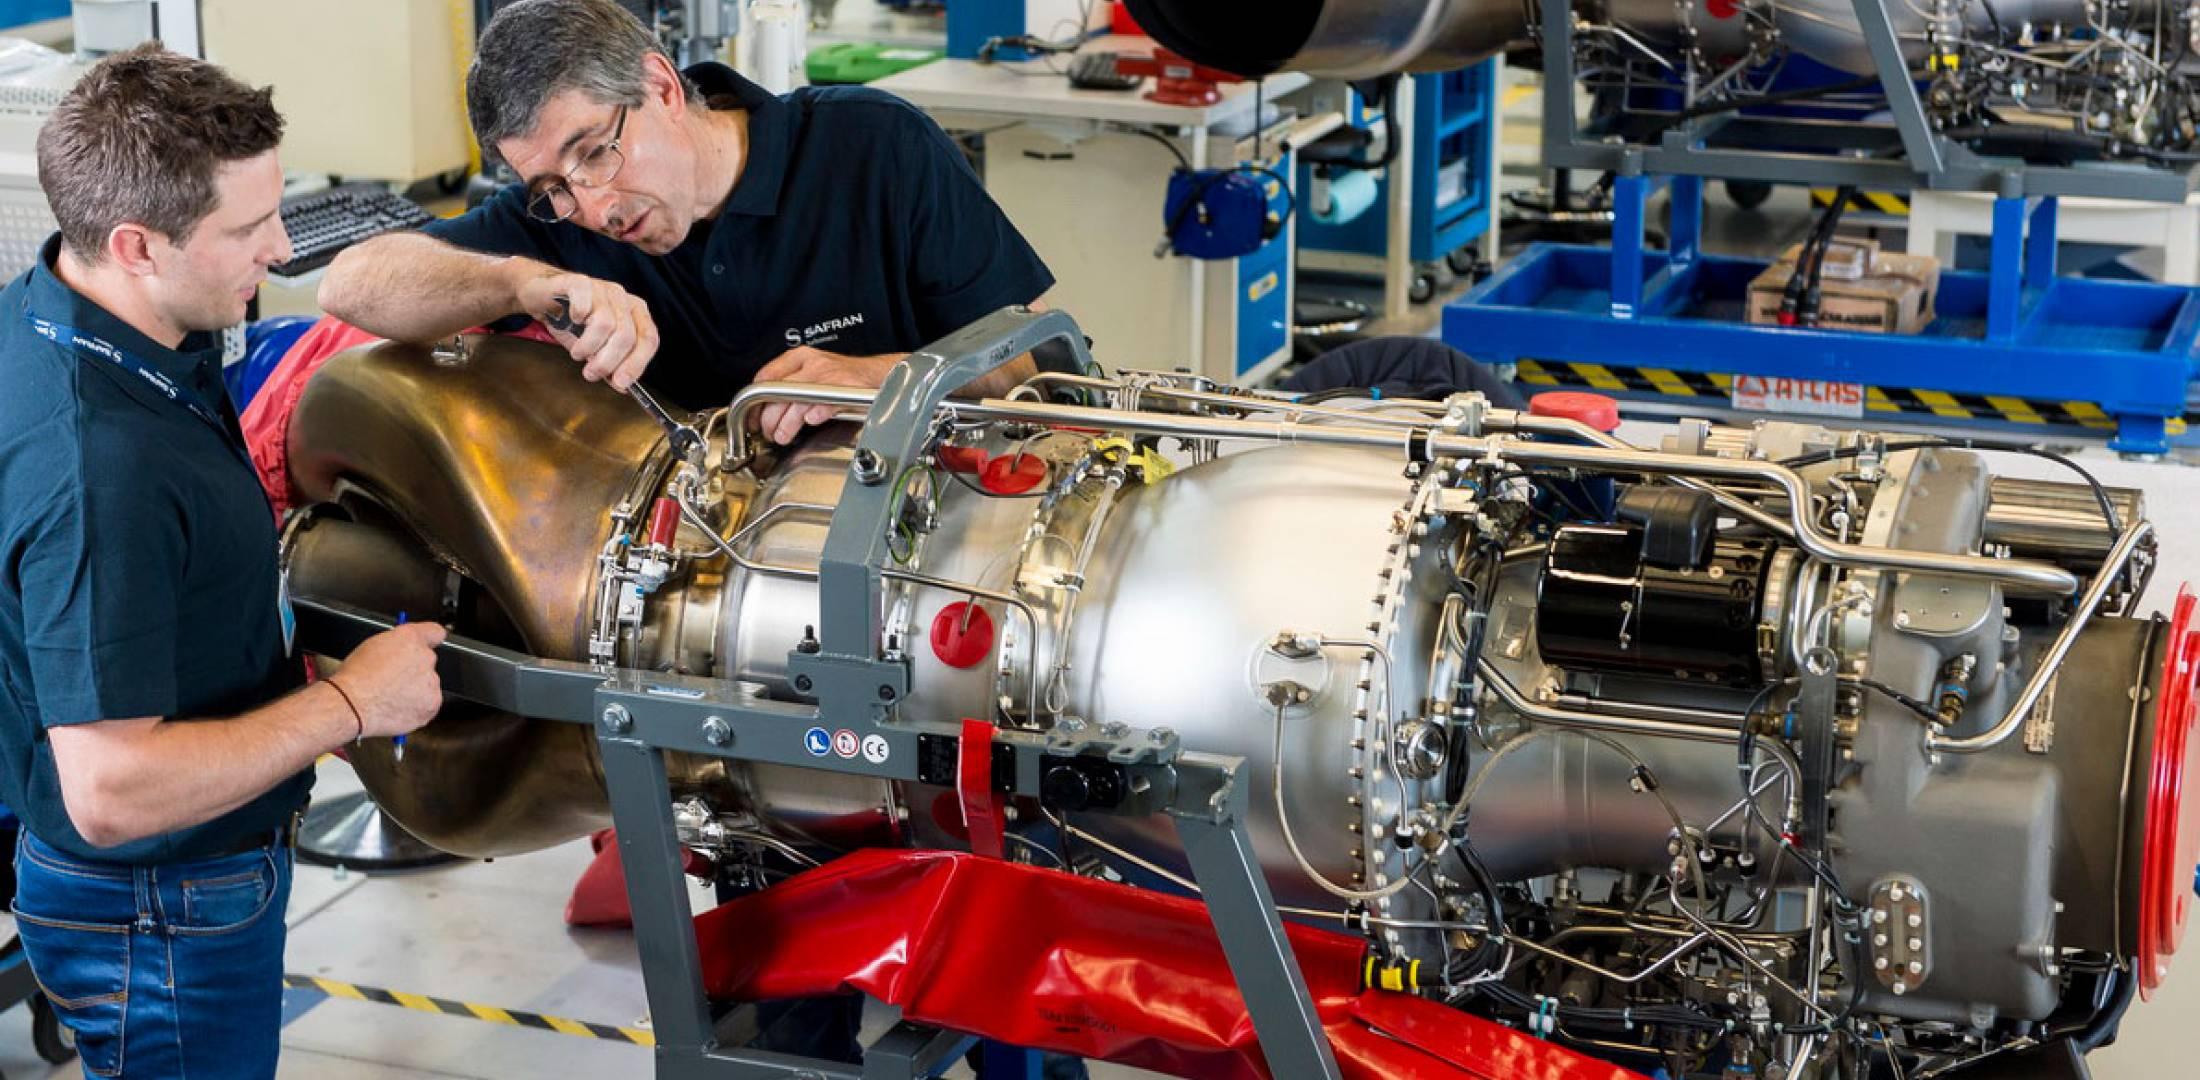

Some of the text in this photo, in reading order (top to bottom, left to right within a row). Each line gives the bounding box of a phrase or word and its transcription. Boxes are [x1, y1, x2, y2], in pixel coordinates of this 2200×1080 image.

[804, 312, 864, 338] SAFRAN
[1775, 378, 1859, 405] ATLAS
[866, 741, 885, 758] CE
